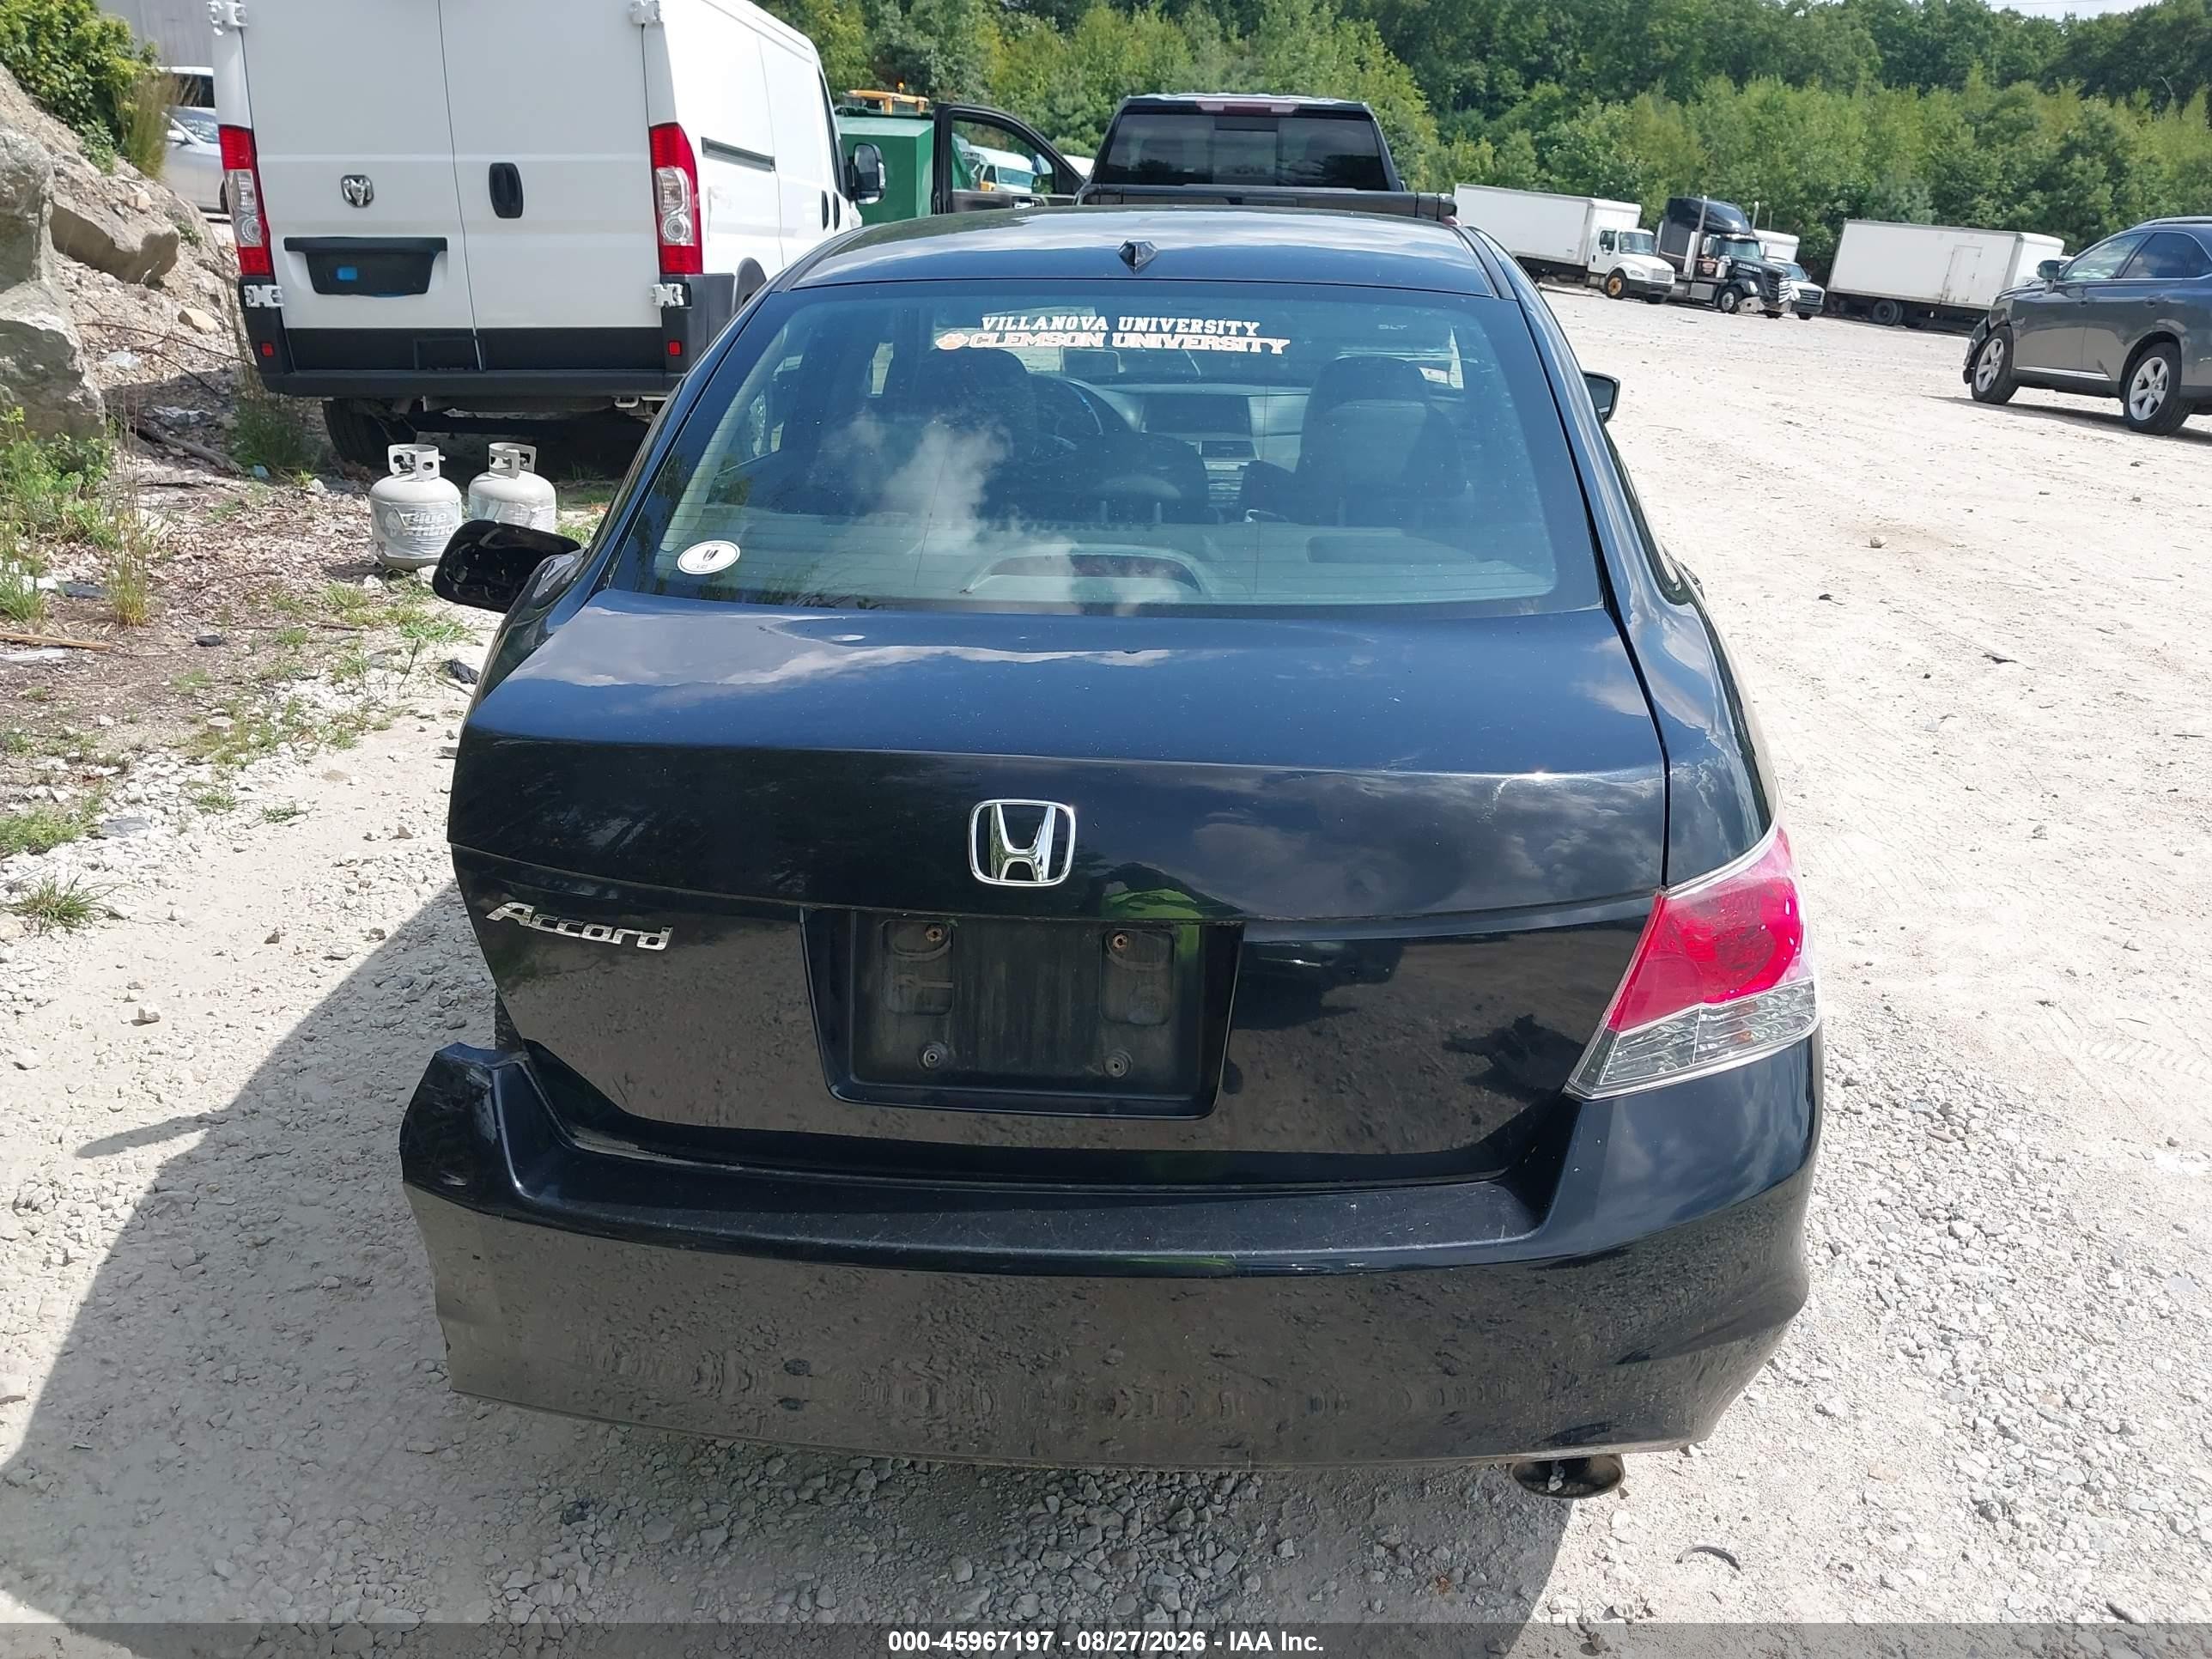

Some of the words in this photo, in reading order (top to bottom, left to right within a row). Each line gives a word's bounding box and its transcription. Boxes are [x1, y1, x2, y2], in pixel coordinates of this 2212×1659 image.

[981, 316, 1109, 331] VILLANOVA
[1118, 316, 1260, 336] UNIVERSITY
[968, 332, 1104, 349] CLEMSON
[1111, 332, 1291, 355] UNIVERSITY
[485, 902, 674, 951] Accord
